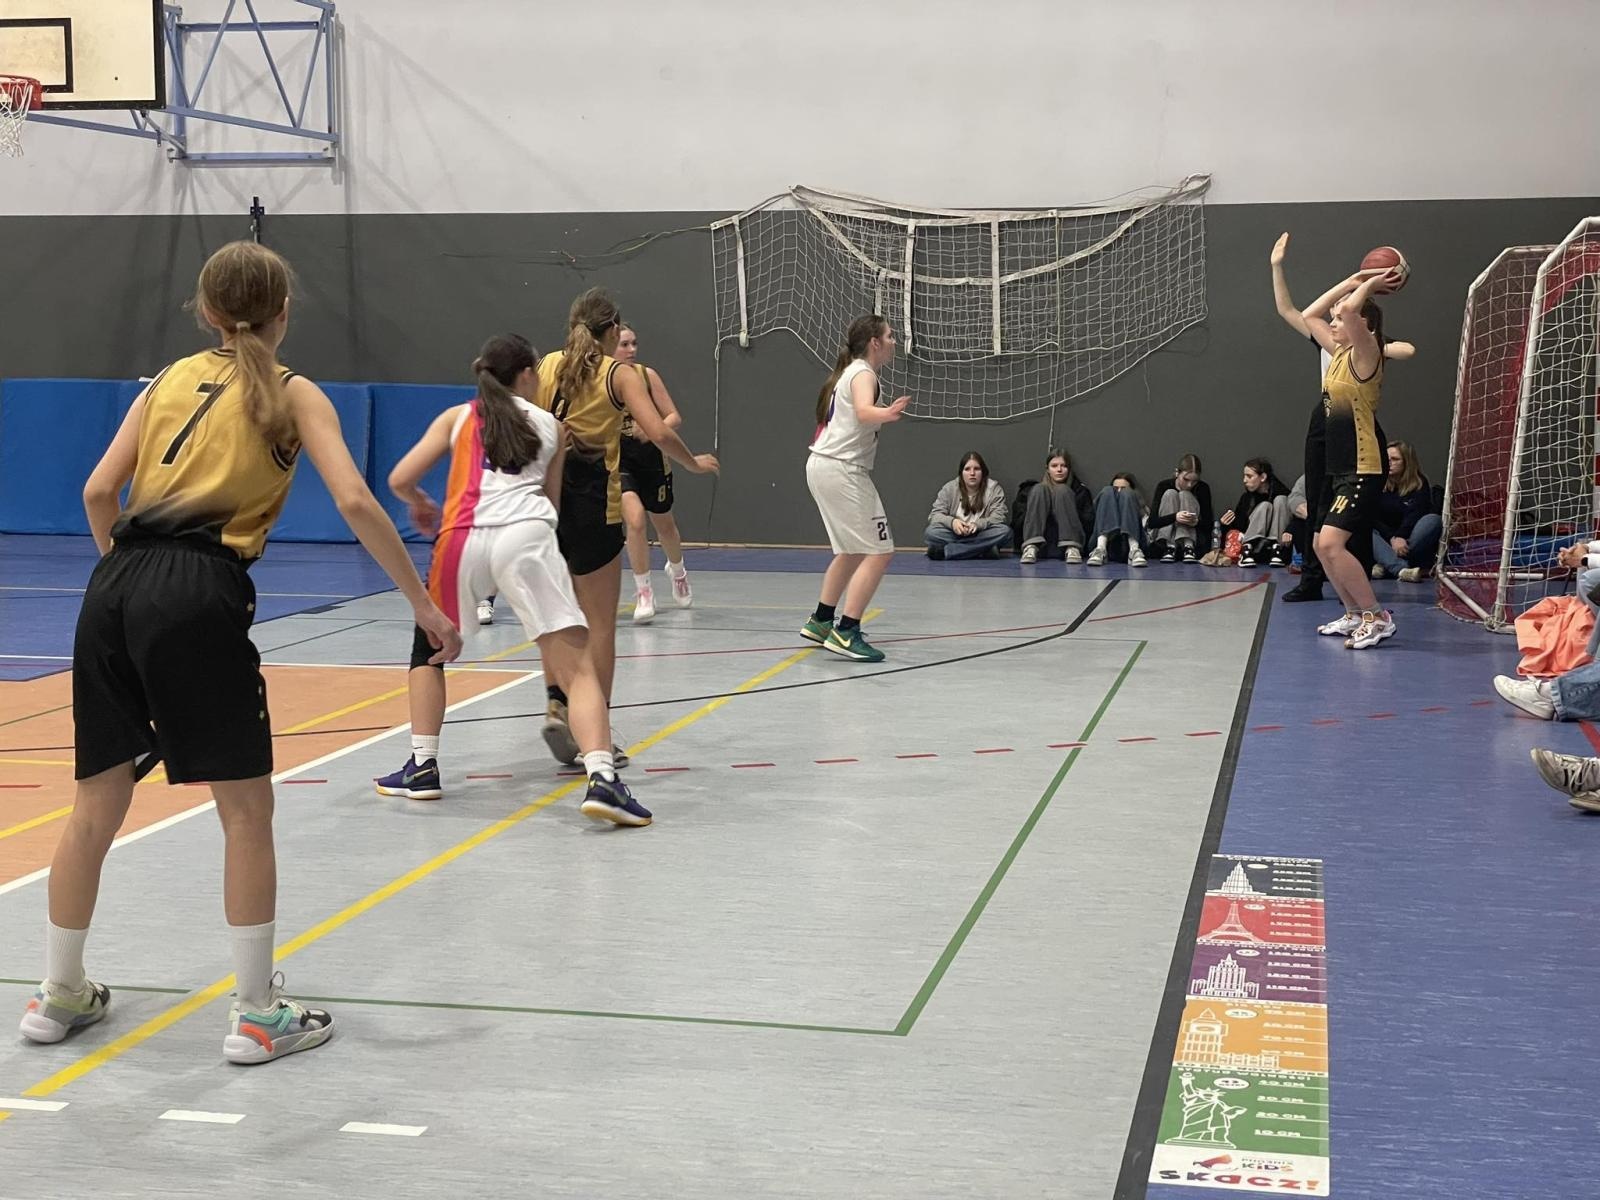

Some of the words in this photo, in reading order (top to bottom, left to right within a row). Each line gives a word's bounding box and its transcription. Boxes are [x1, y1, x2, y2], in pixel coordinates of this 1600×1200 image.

[160, 381, 229, 467] 7
[657, 484, 667, 502] 8
[1329, 495, 1349, 514] 14
